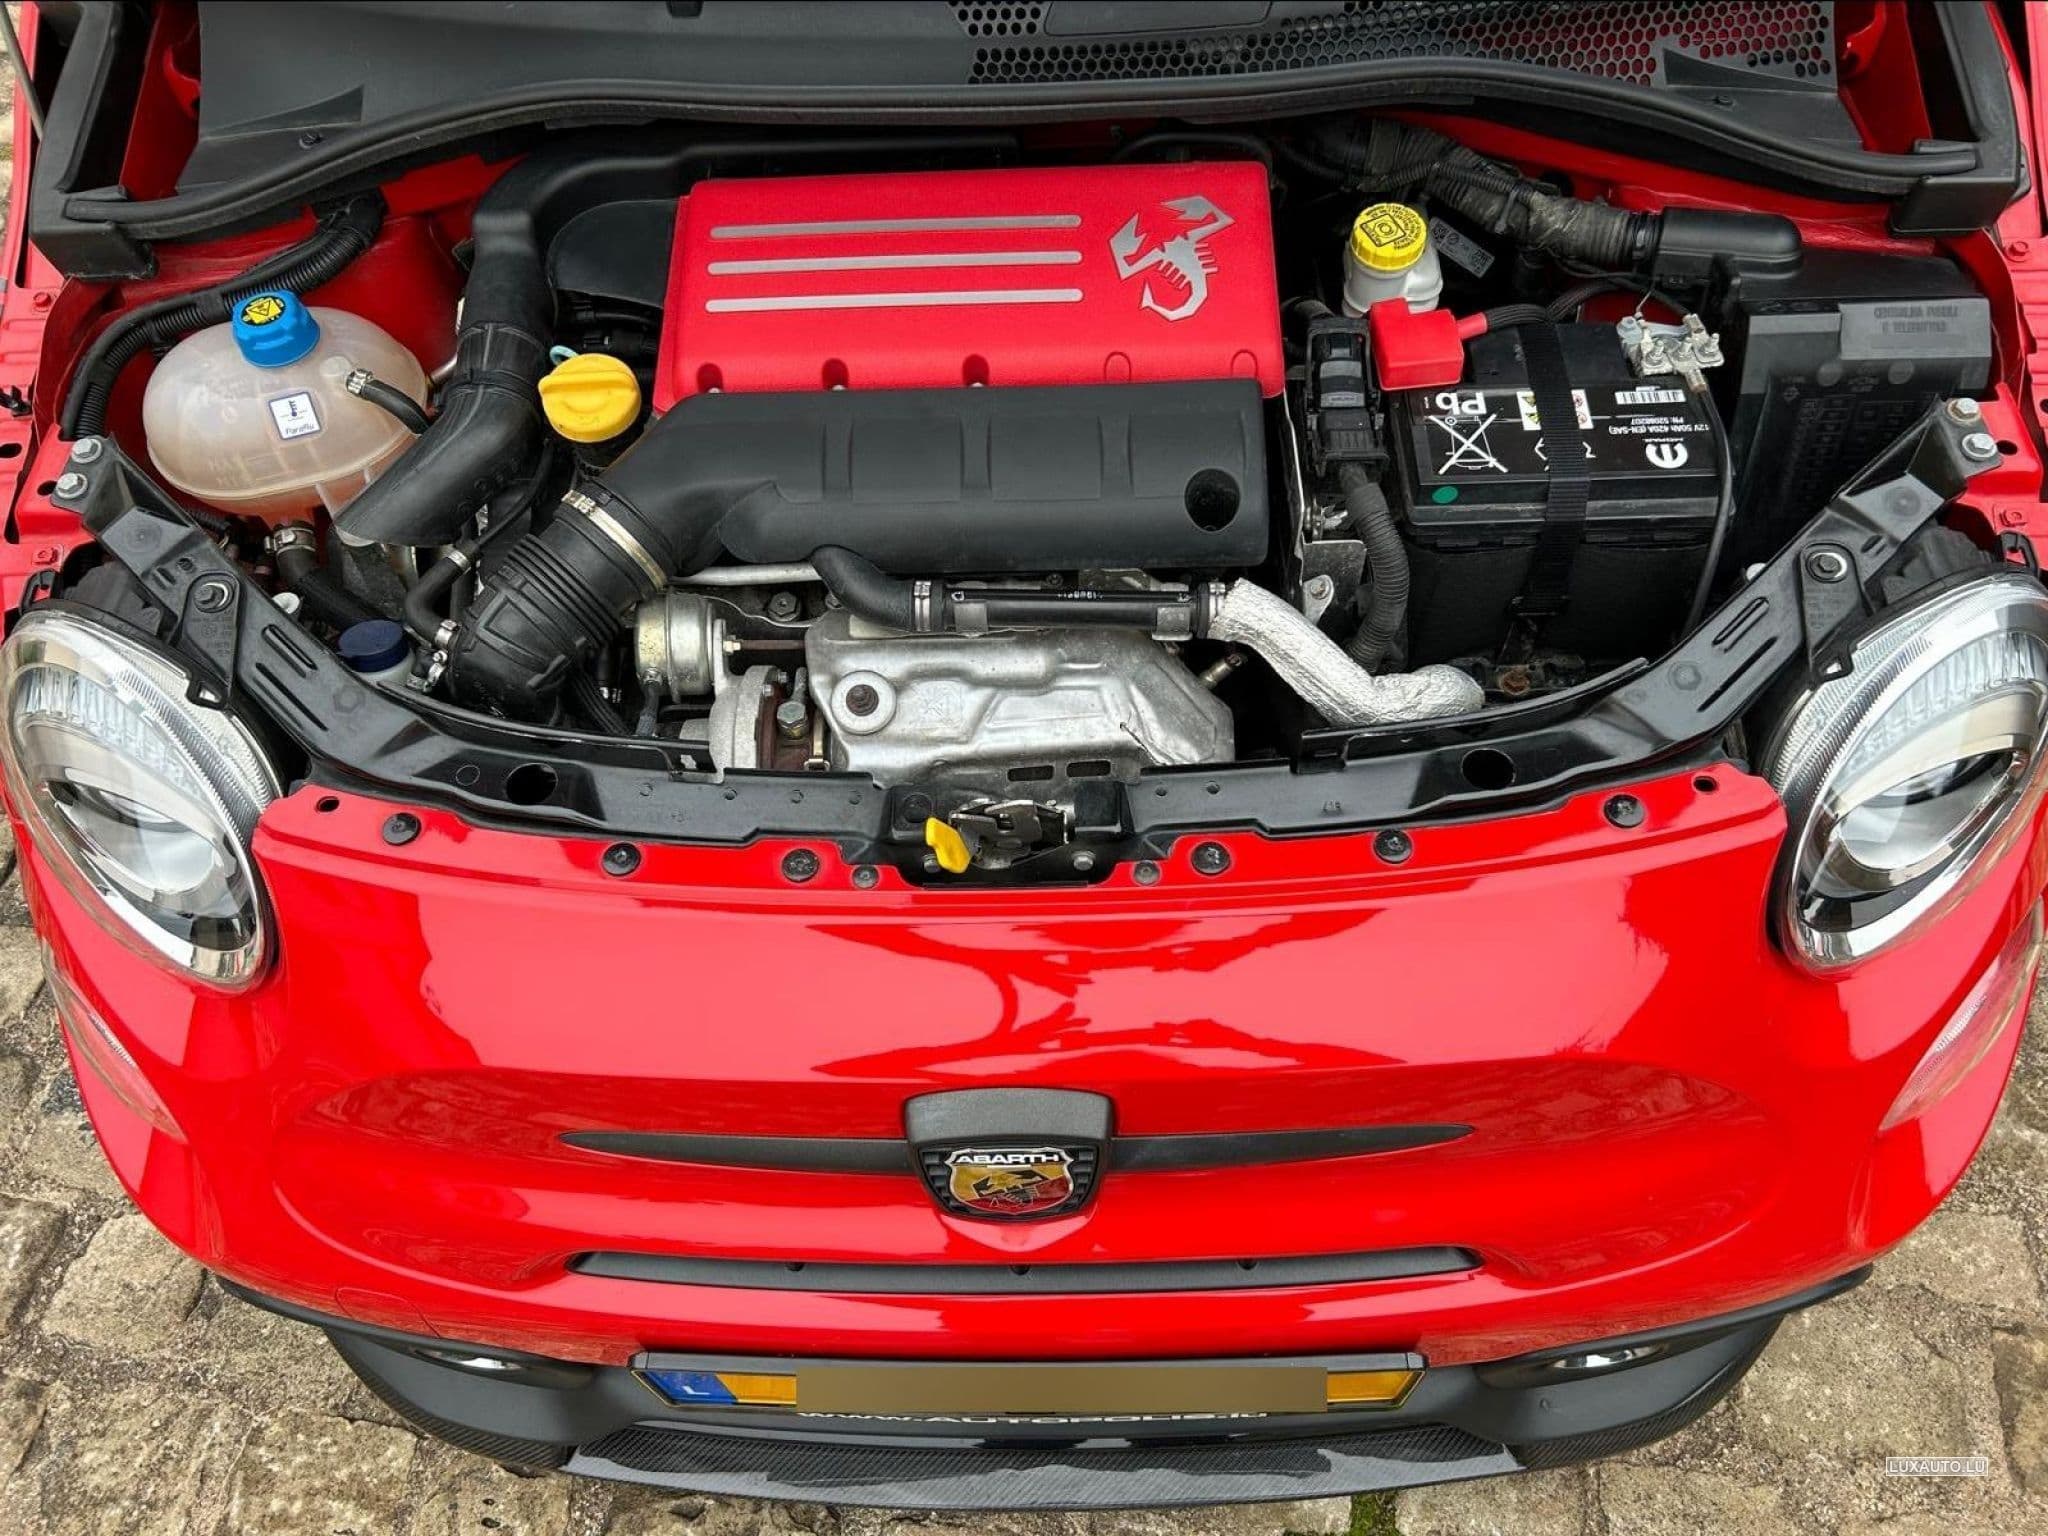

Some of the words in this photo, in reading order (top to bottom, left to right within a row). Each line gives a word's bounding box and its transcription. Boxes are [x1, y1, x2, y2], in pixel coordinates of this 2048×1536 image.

[1435, 392, 1487, 415] Pb
[1694, 424, 1710, 432] 12V
[956, 1154, 1059, 1164] ABARTH
[681, 1385, 711, 1395] L
